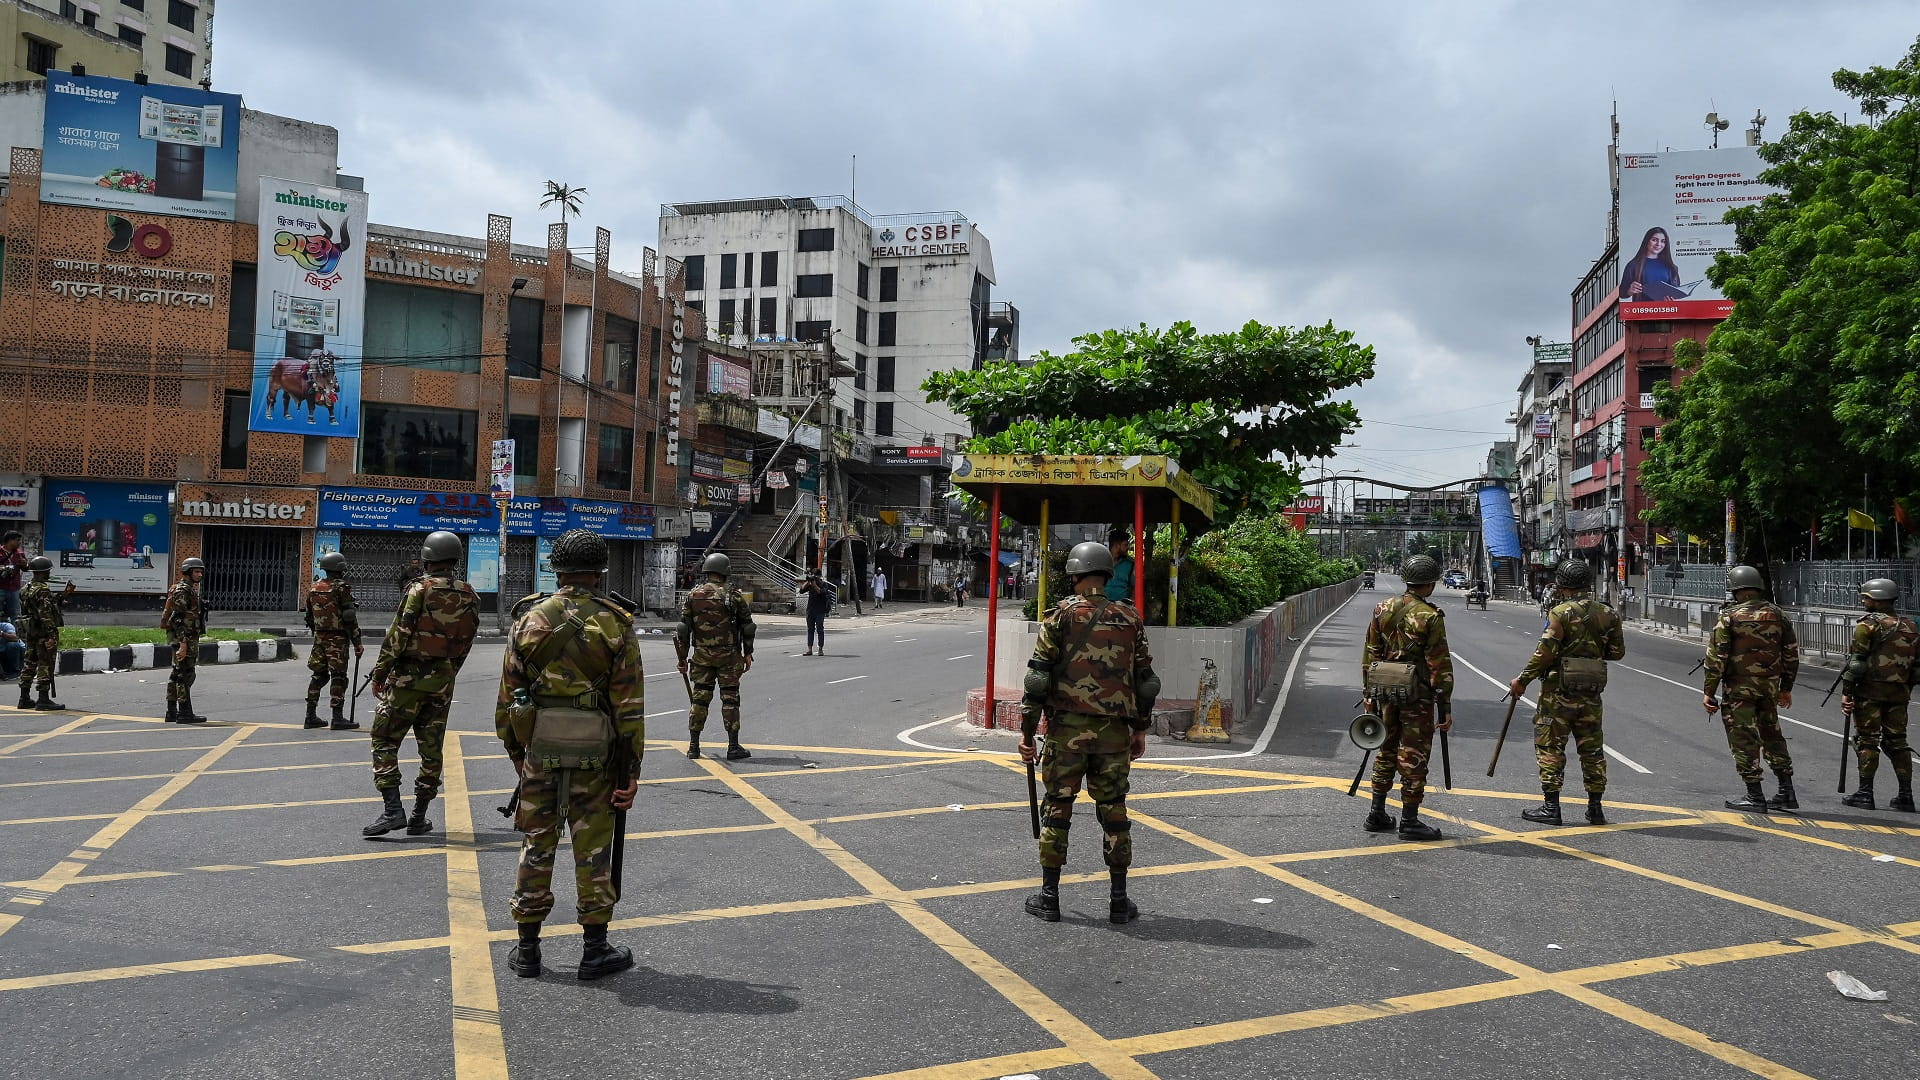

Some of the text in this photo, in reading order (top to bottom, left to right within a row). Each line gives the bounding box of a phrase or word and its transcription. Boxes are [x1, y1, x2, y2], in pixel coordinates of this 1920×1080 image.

[55, 81, 119, 99] minister
[85, 97, 116, 105] Refrigerator
[58, 126, 120, 142] খাবার থাকে
[1624, 155, 1638, 169] UCB
[1675, 172, 1741, 181] Foreign Degrees
[1675, 181, 1695, 189] right
[275, 189, 348, 212] minister
[277, 215, 317, 230] ফ্রিজ কিনুন
[905, 224, 962, 242] CSBF
[872, 242, 968, 257] HEALTH CENTER
[53, 258, 100, 273] আমার
[140, 266, 185, 282] আমার
[187, 271, 215, 283] দেশ
[369, 255, 482, 285] minister
[304, 272, 343, 290] জিতুন
[51, 279, 215, 310] গড়ব বাংলাদেশ
[1631, 306, 1678, 314] 01896013881
[666, 300, 685, 467] minister
[974, 466, 1006, 478] ট্রাফিক
[1009, 468, 1050, 479] তেজগাঁও
[1089, 469, 1129, 480] ডিএমপি
[128, 492, 163, 500] minister
[708, 485, 732, 500] SONY
[421, 493, 492, 508] ASIA
[182, 498, 306, 520] minister
[342, 505, 398, 513] SHACKLOCK
[507, 511, 533, 519] ITACHI
[621, 505, 655, 517] ASIA
[660, 518, 673, 532] UT
